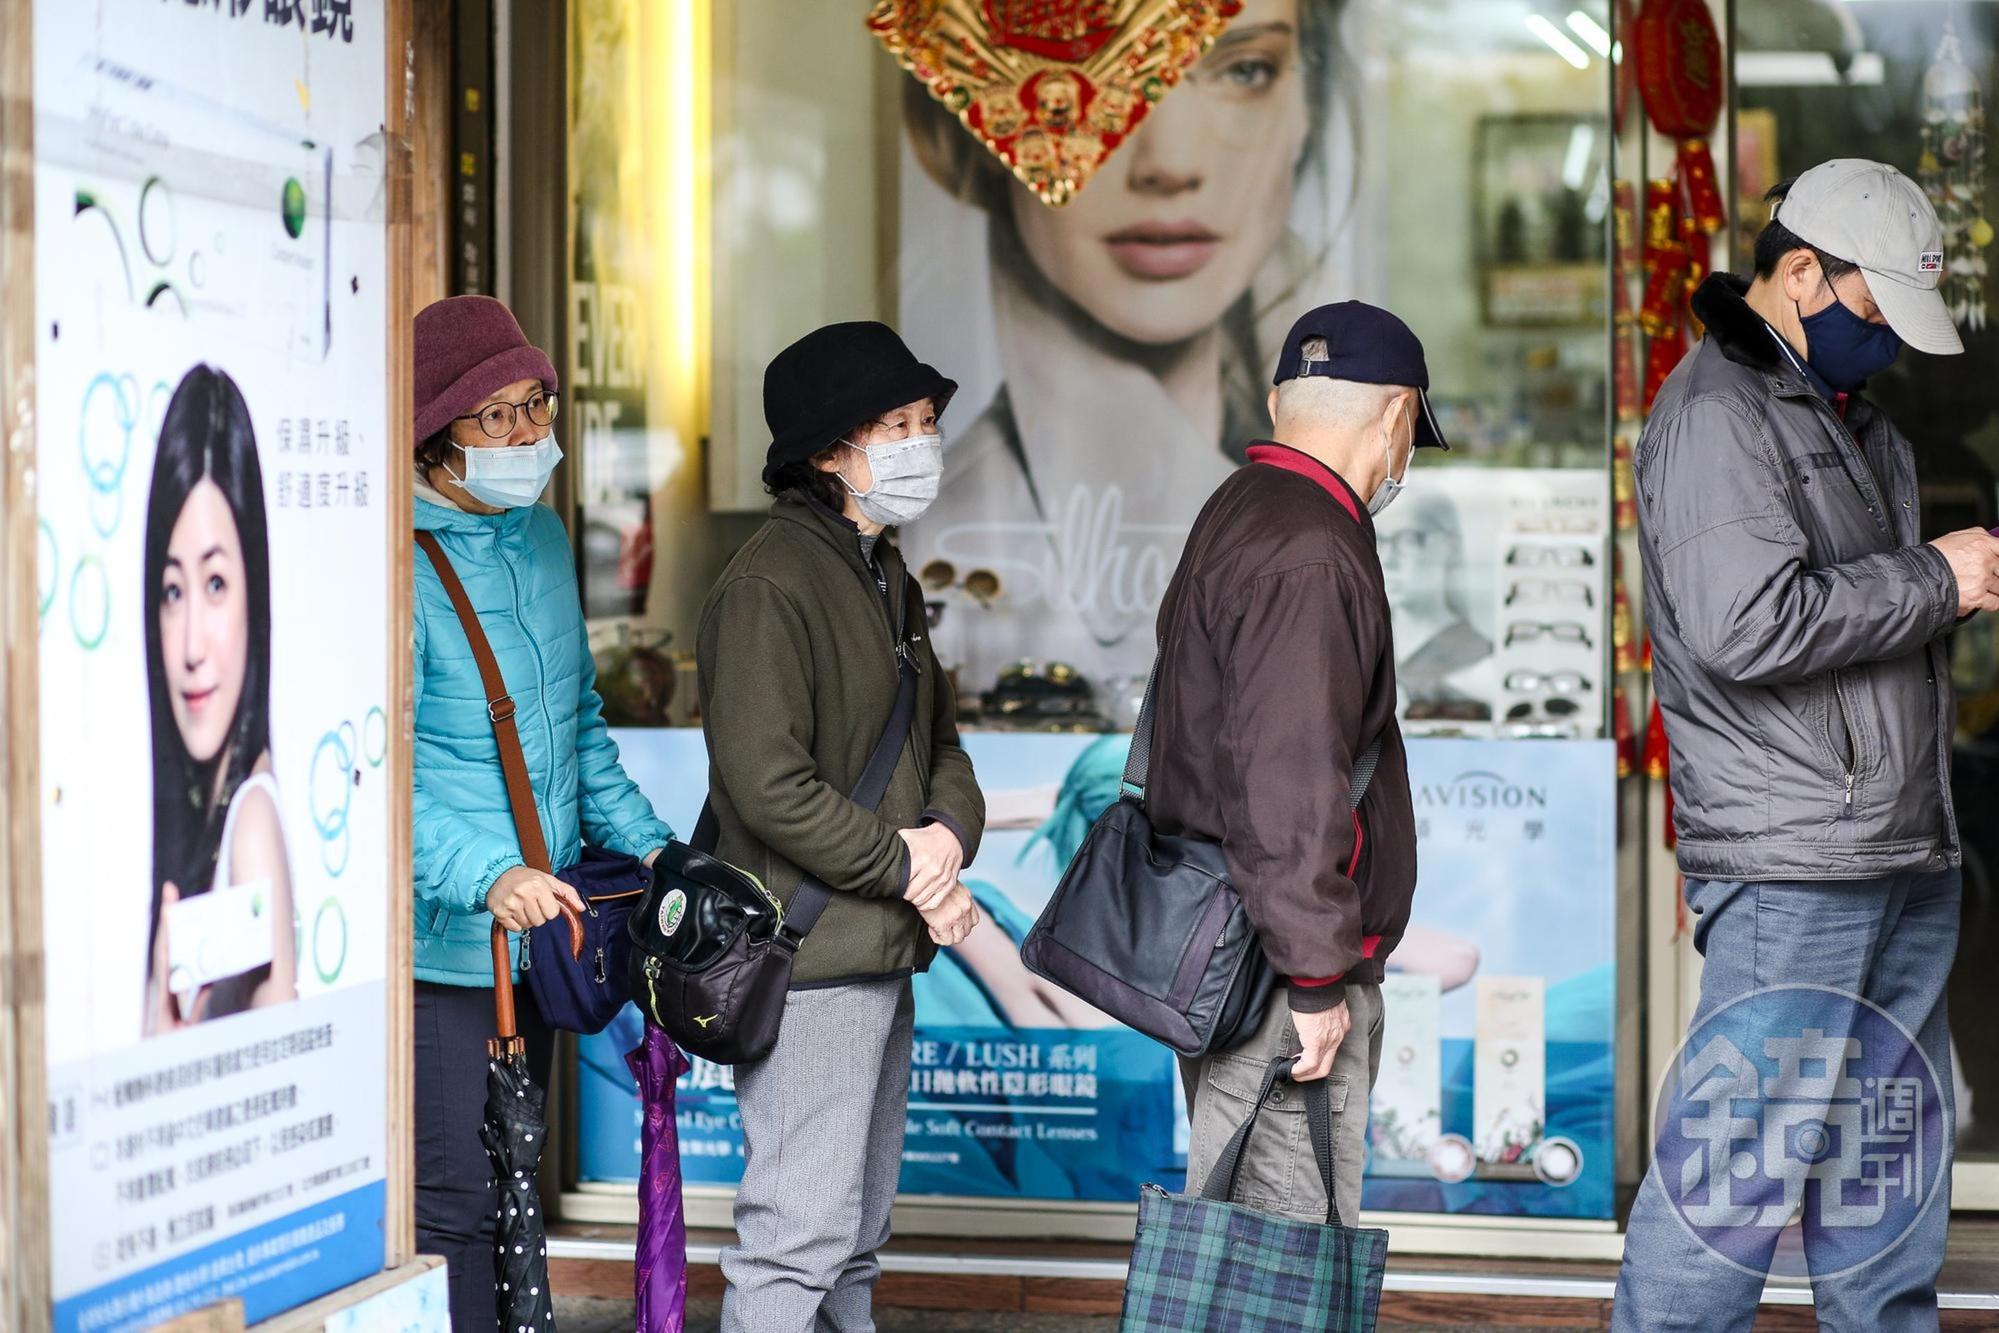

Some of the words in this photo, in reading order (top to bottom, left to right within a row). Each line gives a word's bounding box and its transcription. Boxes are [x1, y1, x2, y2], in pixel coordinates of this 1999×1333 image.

[966, 1043, 1039, 1069] LUSH
[1049, 1044, 1097, 1071] 系列
[926, 1119, 961, 1137] Soft
[965, 1121, 1033, 1140] Contact
[1037, 1123, 1098, 1142] Lenses
